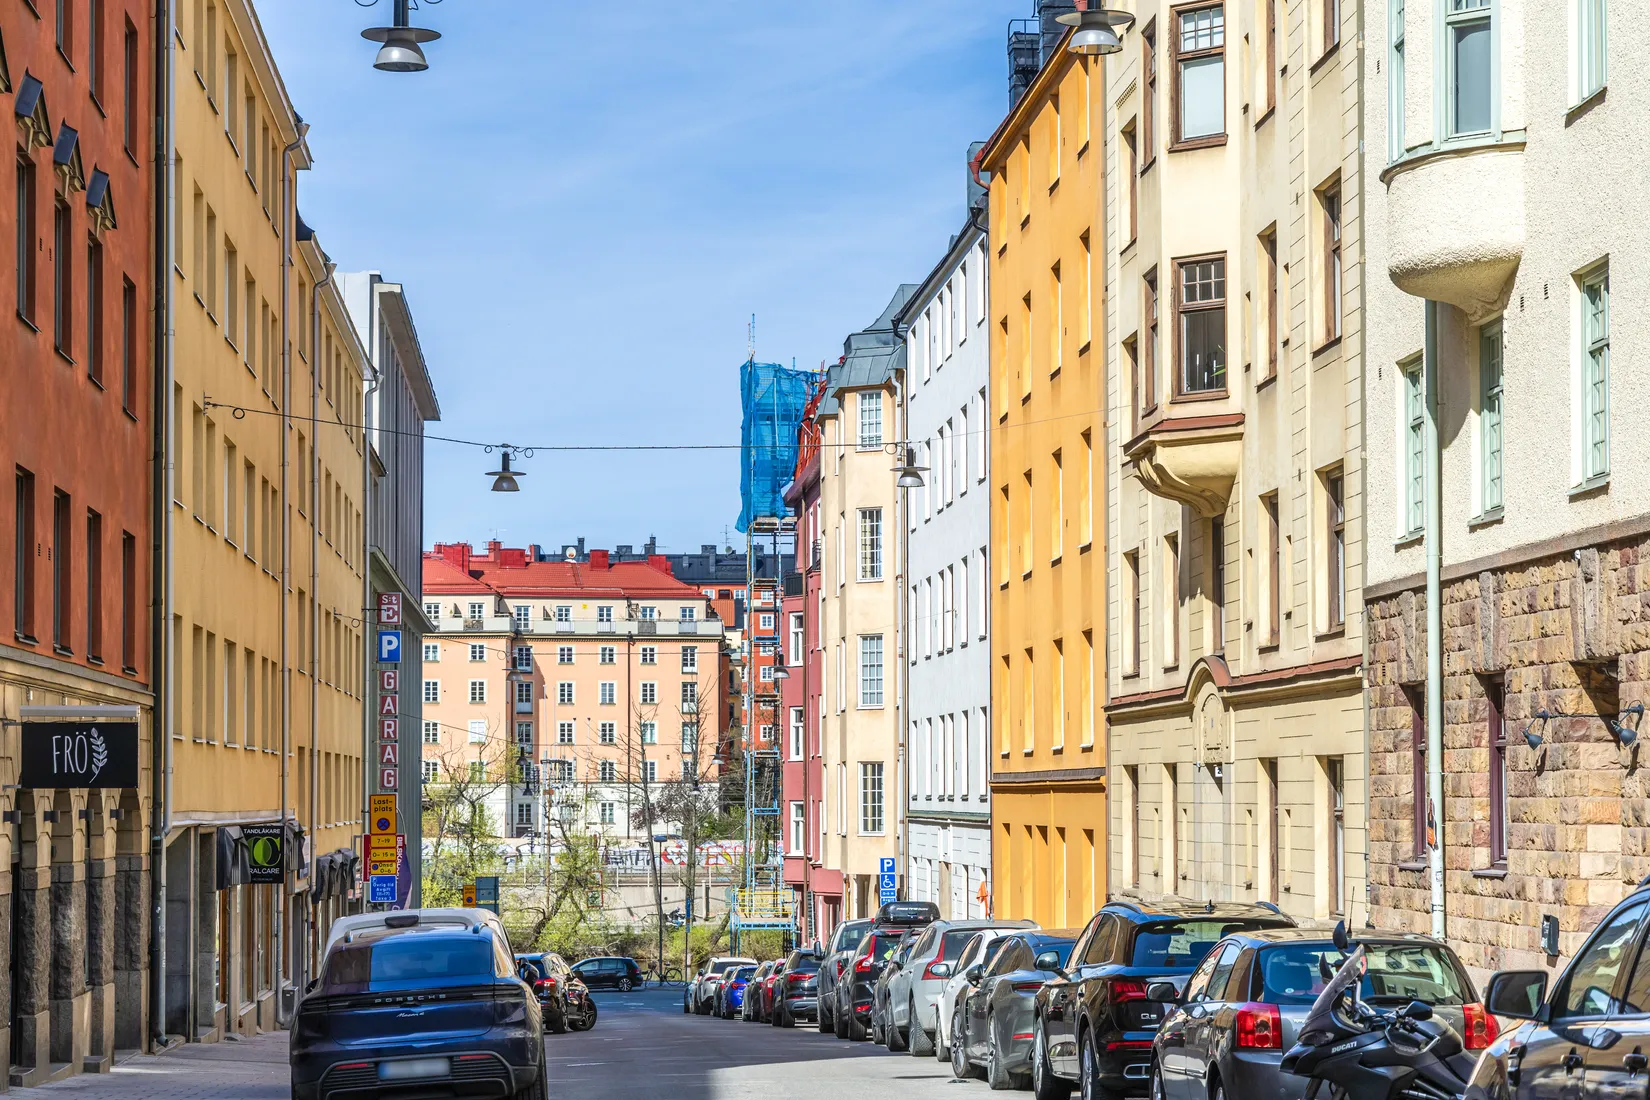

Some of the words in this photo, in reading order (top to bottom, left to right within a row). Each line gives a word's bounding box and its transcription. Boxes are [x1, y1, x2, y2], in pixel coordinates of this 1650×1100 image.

[381, 605, 398, 622] E
[382, 635, 398, 658] P
[382, 672, 395, 787] GARAG
[52, 731, 88, 774] FRÖ
[884, 859, 893, 872] P
[375, 994, 446, 1003] PORSCHE
[1331, 1041, 1358, 1054] DUCATI
